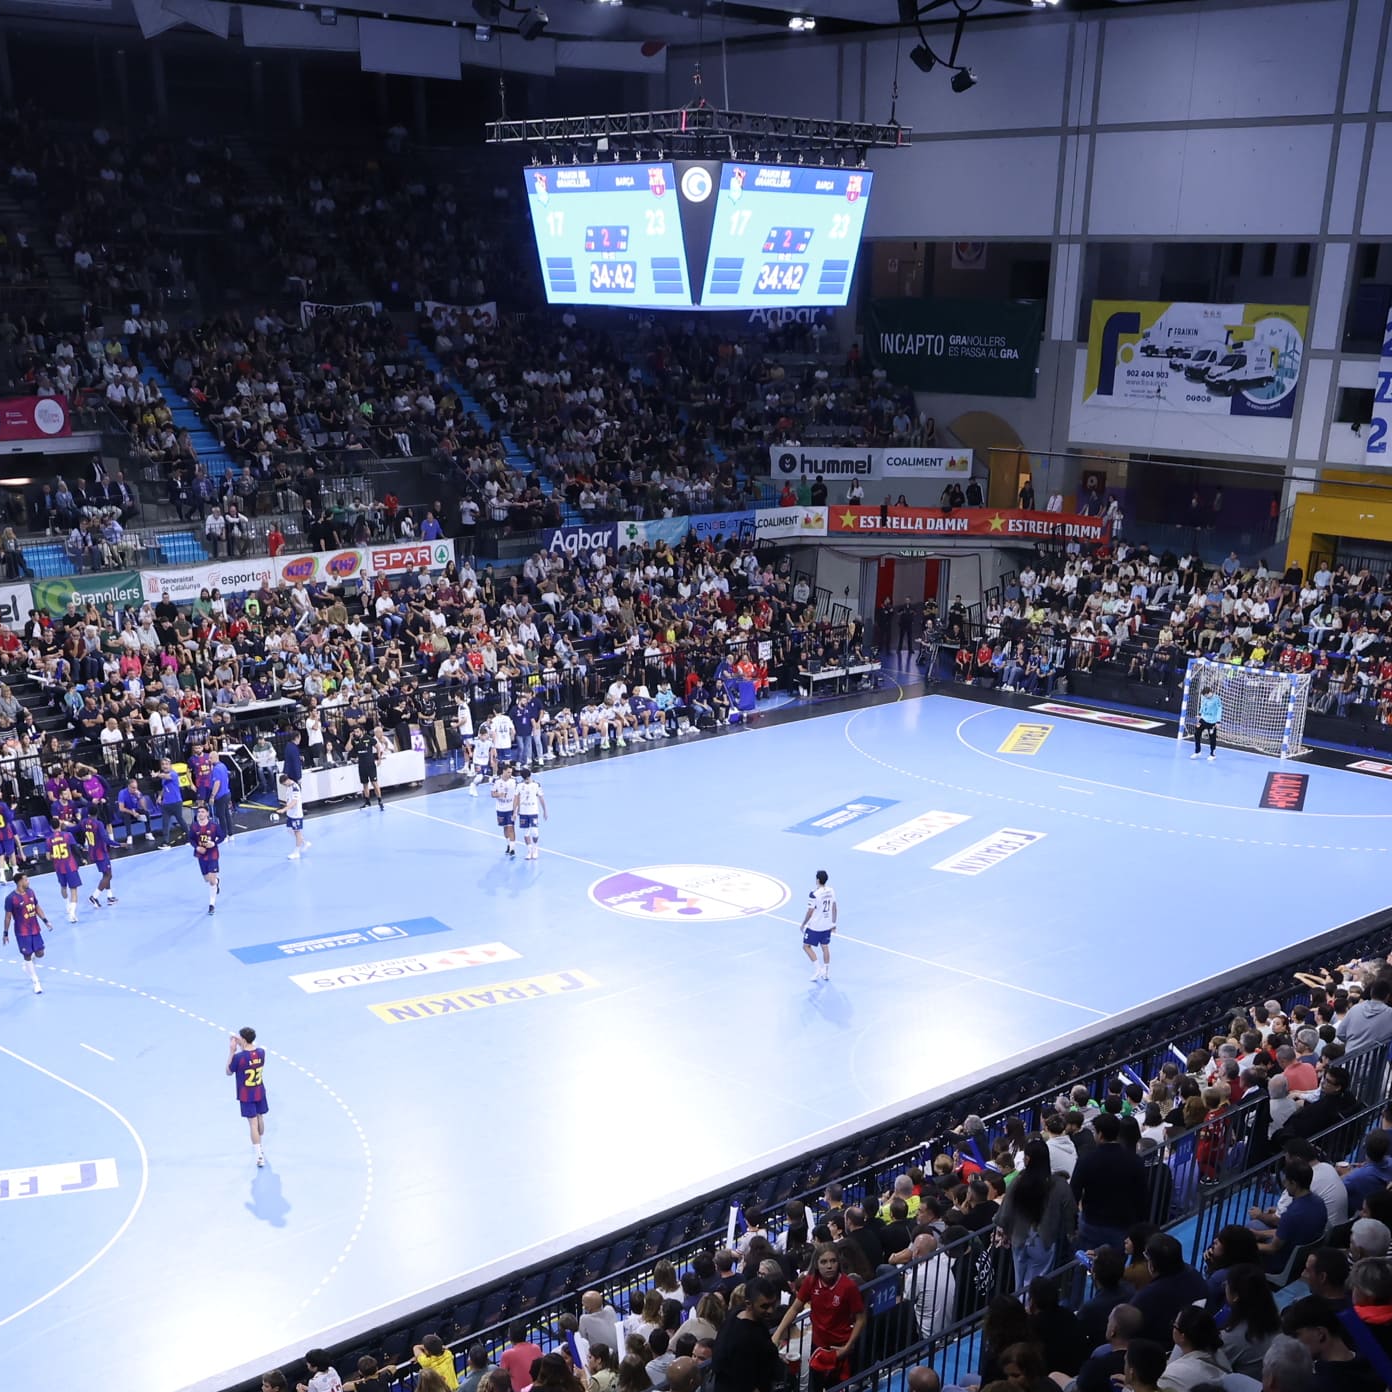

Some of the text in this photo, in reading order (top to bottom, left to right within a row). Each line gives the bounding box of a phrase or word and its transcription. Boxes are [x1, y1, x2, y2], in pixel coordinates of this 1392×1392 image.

[547, 211, 564, 236] 17
[646, 209, 665, 235] 23
[730, 210, 752, 236] 17
[828, 213, 851, 239] 23
[601, 228, 610, 247] 2
[783, 230, 792, 247] 2
[591, 264, 634, 288] 34:42
[758, 265, 804, 290] 34:42
[880, 333, 944, 356] INCAPTO
[949, 335, 1006, 347] GRANOLLERS
[948, 347, 1019, 359] ES PASSA AL GRA
[1141, 370, 1155, 378] 404
[1366, 417, 1388, 453] 2
[800, 454, 872, 475] hummel
[886, 456, 943, 468] COALIMENT
[758, 515, 799, 528] COALIMENT
[859, 515, 968, 531] ESTRELLA DAMM
[1064, 523, 1101, 539] DAMM
[549, 528, 612, 558] Agbar
[374, 549, 431, 567] SPAR
[221, 571, 271, 587] esportcat
[71, 587, 140, 608] Granollers
[1267, 773, 1301, 808] LALIGA+
[950, 840, 1026, 873] FRAIKIN
[312, 961, 428, 989] nexus
[387, 983, 548, 1021] FRAIKIN
[244, 1066, 264, 1087] 23
[877, 1285, 896, 1305] 112
